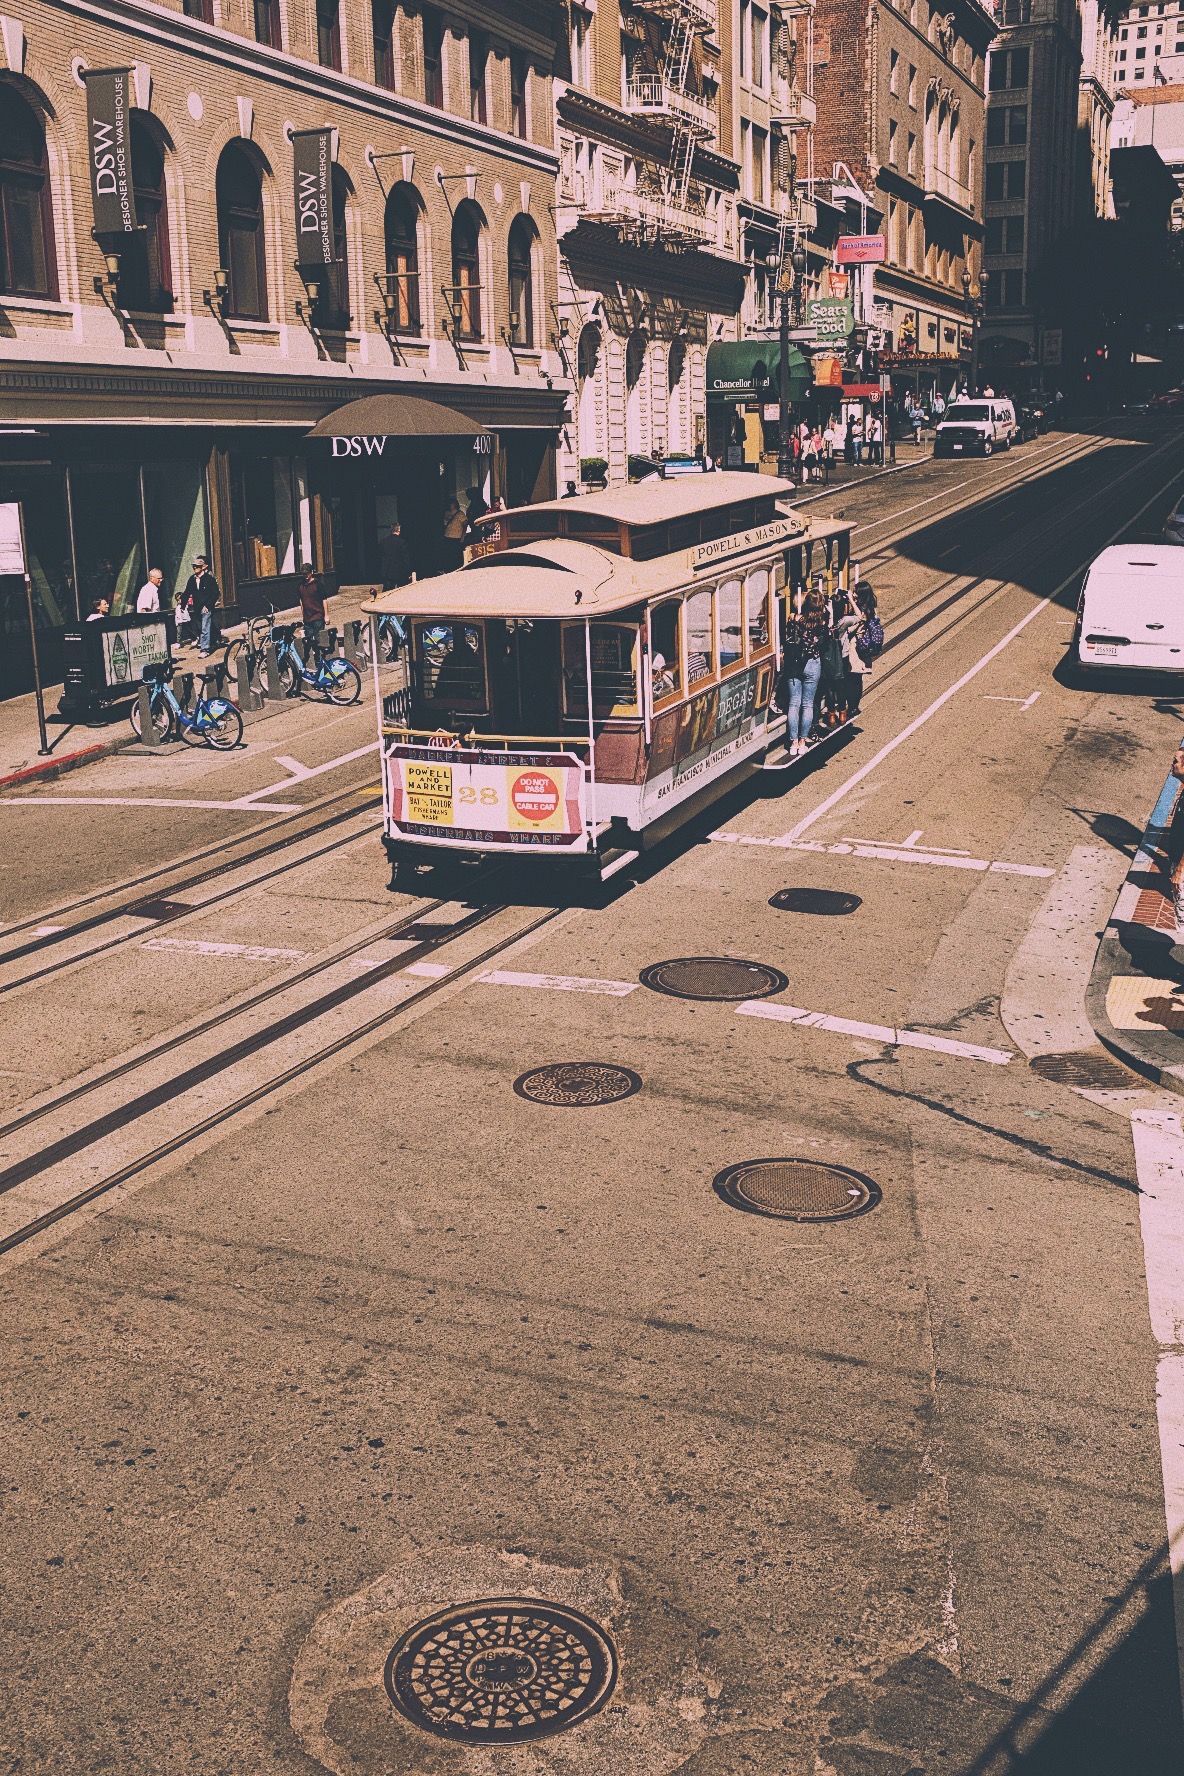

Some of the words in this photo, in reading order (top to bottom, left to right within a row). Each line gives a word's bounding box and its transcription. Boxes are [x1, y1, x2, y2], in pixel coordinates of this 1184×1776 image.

[114, 76, 125, 145] WAREHOUSE
[93, 118, 118, 197] DSW
[116, 147, 126, 177] SHOE
[319, 135, 327, 192] WAREHOUSE
[118, 179, 133, 232] DESIGNER
[298, 169, 319, 235] DSW
[319, 193, 328, 218] SHOE
[321, 220, 332, 263] DESIGNER
[811, 302, 848, 319] Sears
[713, 378, 751, 389] Chancellor
[331, 435, 388, 457] DSW
[697, 537, 741, 559] POWELL
[744, 533, 752, 545] &
[755, 523, 788, 541] MASON
[132, 643, 155, 656] WORTH
[141, 633, 157, 645] SHOT
[148, 650, 169, 662] TAKING
[717, 684, 755, 720] DEGAS
[408, 767, 450, 779] POWELL
[520, 778, 532, 786] DO
[533, 778, 550, 787] NOT
[657, 783, 671, 799] SAN
[672, 762, 704, 791] FRANCISCO
[408, 781, 451, 792] MARKET
[458, 785, 499, 806] 28
[525, 785, 545, 794] PASS
[409, 796, 421, 806] BAY
[429, 798, 452, 809] TAYLOR
[516, 802, 539, 810] CABLE
[539, 803, 555, 811] CAR
[510, 832, 563, 844] WHARF
